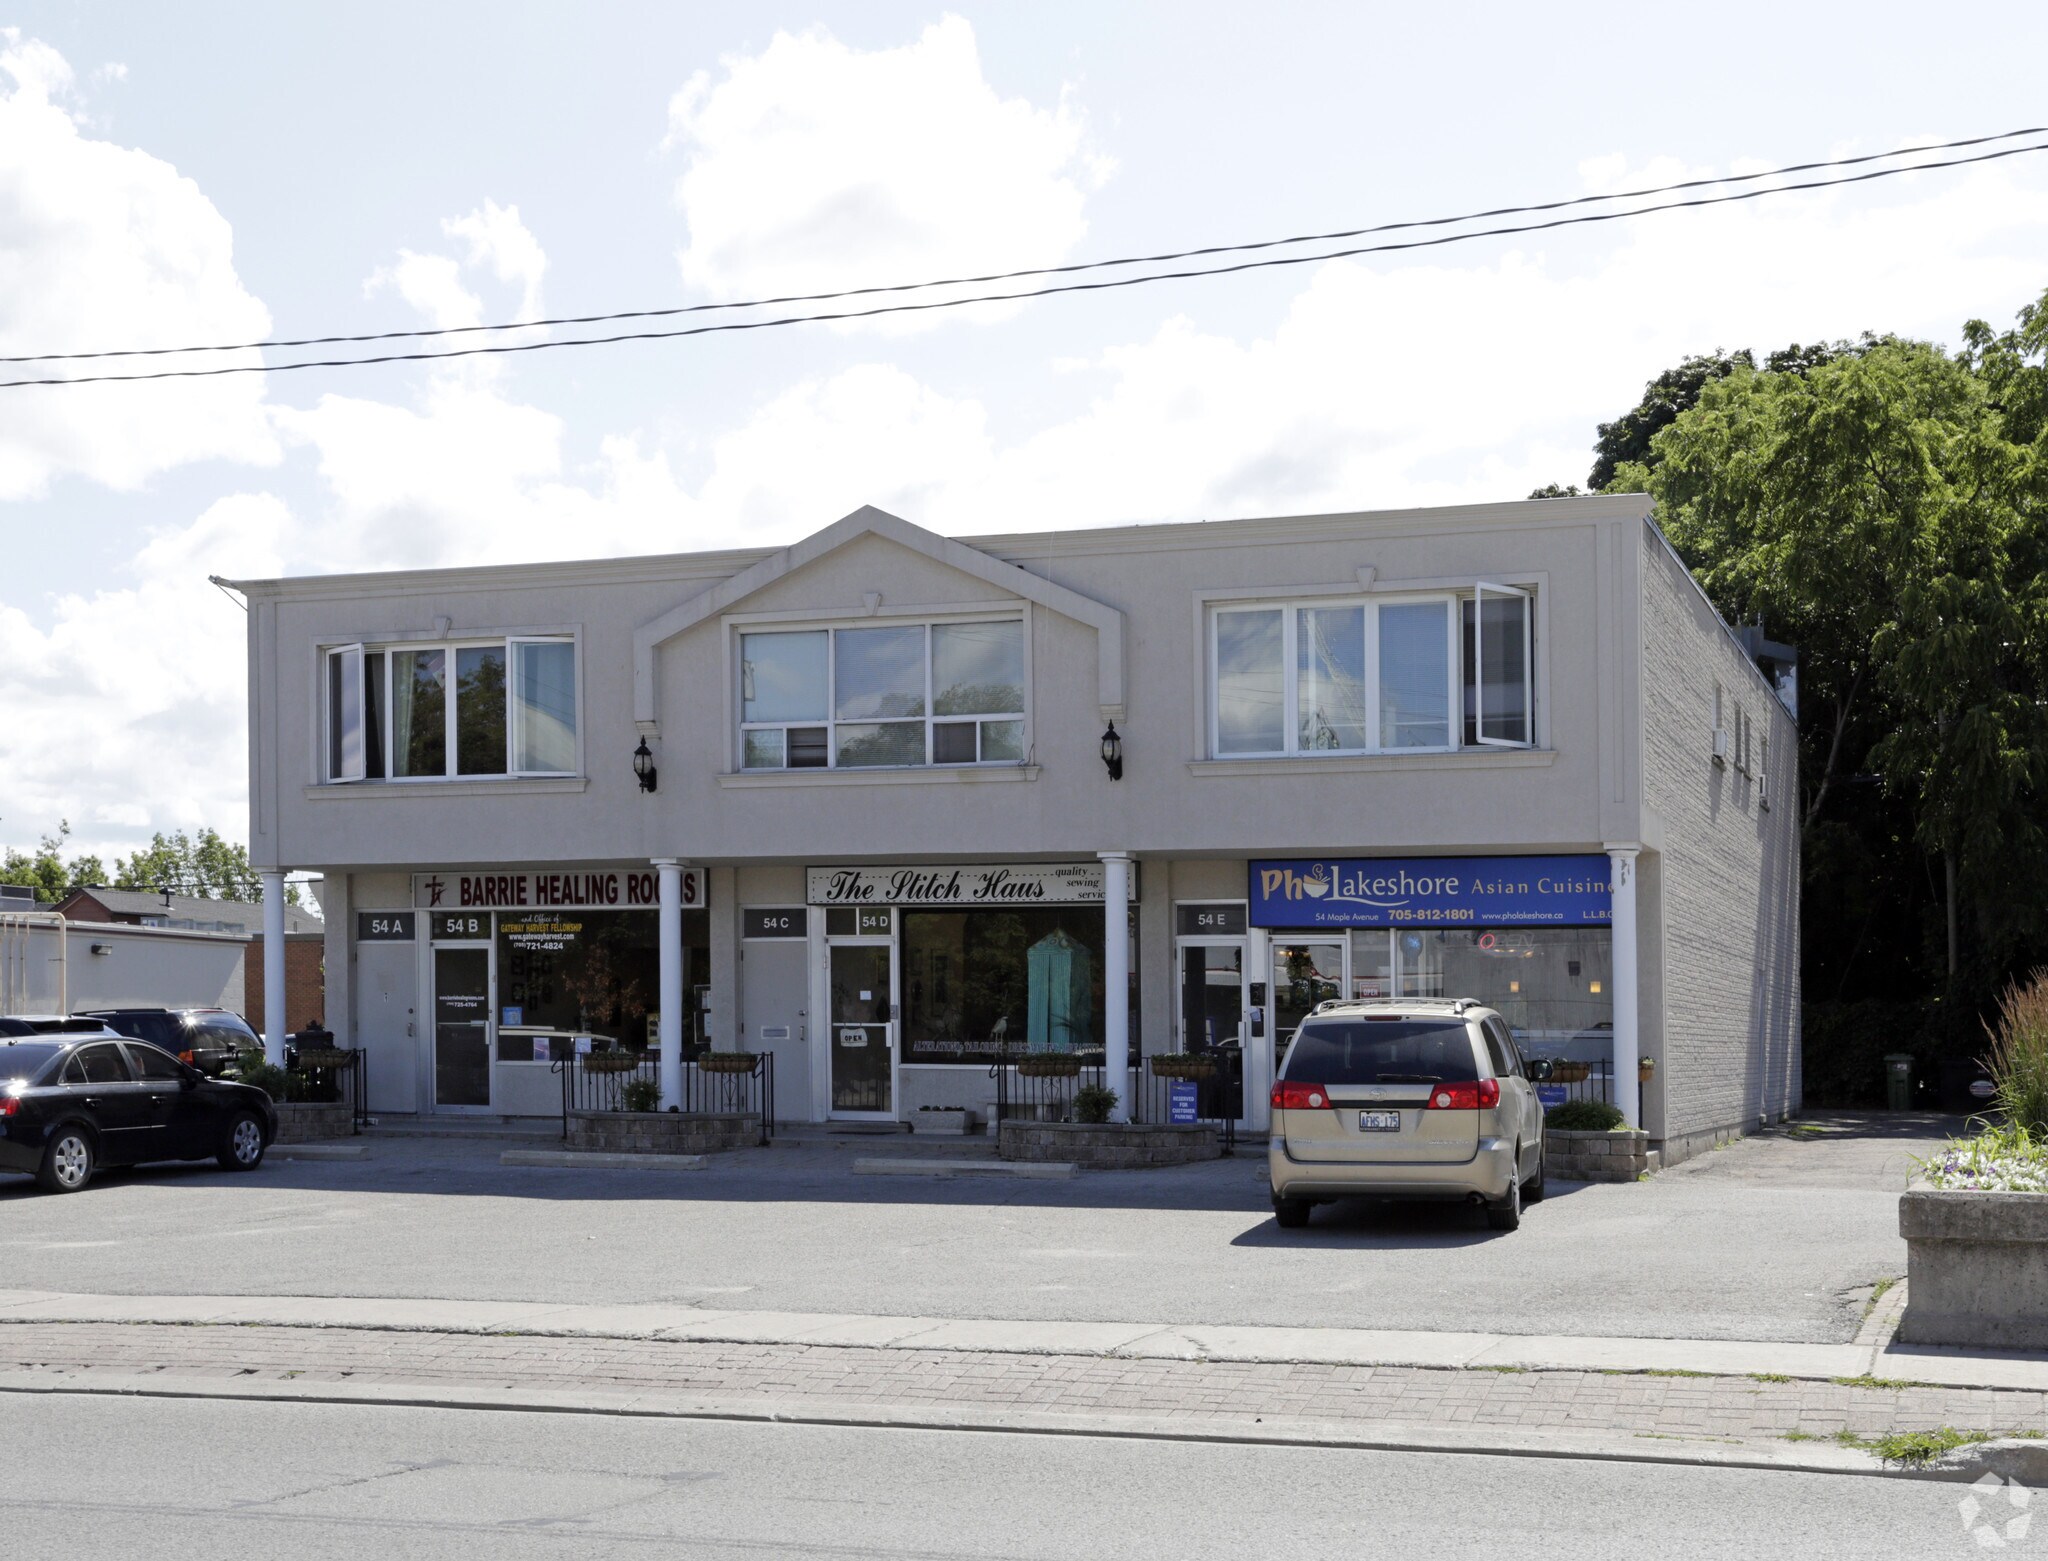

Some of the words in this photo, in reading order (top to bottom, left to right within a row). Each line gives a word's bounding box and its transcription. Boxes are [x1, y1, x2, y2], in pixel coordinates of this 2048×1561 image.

[1055, 866, 1088, 877] quality
[826, 871, 874, 900] The
[886, 870, 961, 900] Stitch
[973, 869, 1045, 899] Haus
[1066, 877, 1099, 888] sewing
[1330, 866, 1458, 901] Lakeshore
[1471, 879, 1528, 894] Asian
[460, 876, 527, 906] BARRIE
[536, 874, 618, 904] HEALING
[627, 873, 696, 904] ROS
[1078, 889, 1105, 899] servic
[534, 914, 551, 924] Office
[1198, 914, 1213, 925] 54
[1217, 914, 1225, 925] E
[1315, 913, 1325, 921] 54
[1327, 913, 1350, 922] Maple
[1352, 913, 1379, 921] Avenue
[1387, 909, 1475, 920] 705-812-1801
[1482, 910, 1563, 921] www.pholakeshore.ca
[372, 920, 388, 933] 54
[392, 920, 403, 933] A
[446, 919, 464, 932] 54
[468, 920, 478, 932] B
[763, 917, 777, 928] 54
[780, 917, 789, 928] C
[862, 916, 876, 927] 54
[880, 916, 888, 926] D
[500, 923, 524, 933] GATEWAY
[526, 923, 549, 933] HARVEST
[551, 923, 583, 932] FELLOWSHIP
[526, 942, 564, 950] 721-4824
